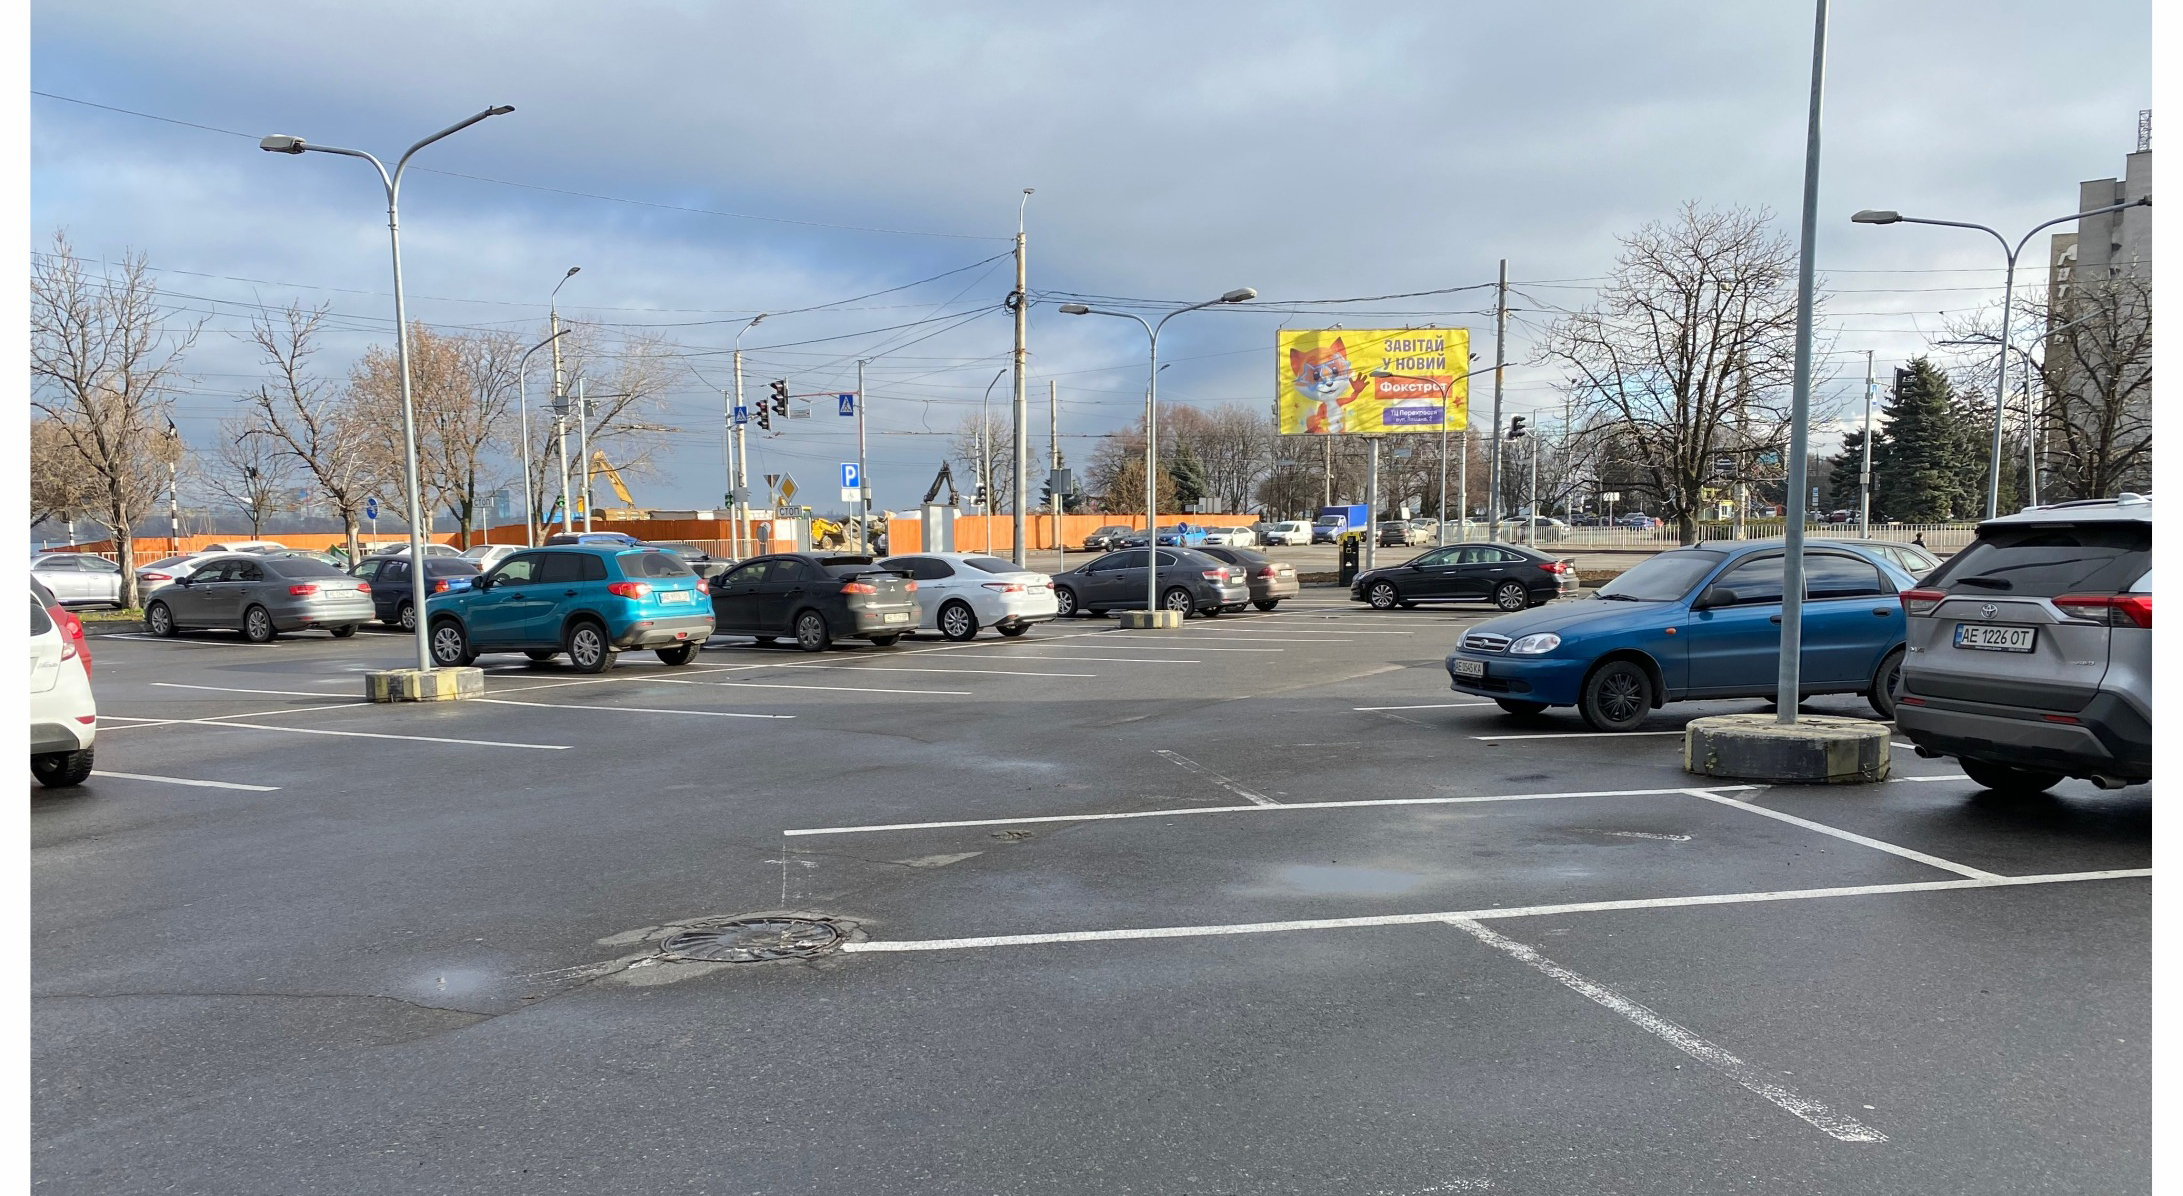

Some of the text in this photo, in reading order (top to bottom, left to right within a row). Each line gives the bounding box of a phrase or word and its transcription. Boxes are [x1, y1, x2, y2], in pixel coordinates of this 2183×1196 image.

[1384, 335, 1444, 352] ЗАВІТАЙ
[1382, 353, 1446, 370] У НОВИЙ
[1380, 381, 1448, 393] Фокстрот
[845, 465, 856, 486] P
[779, 507, 801, 516] СТОП
[1961, 628, 2030, 646] AE 1226 OT
[1473, 663, 1482, 675] KA
